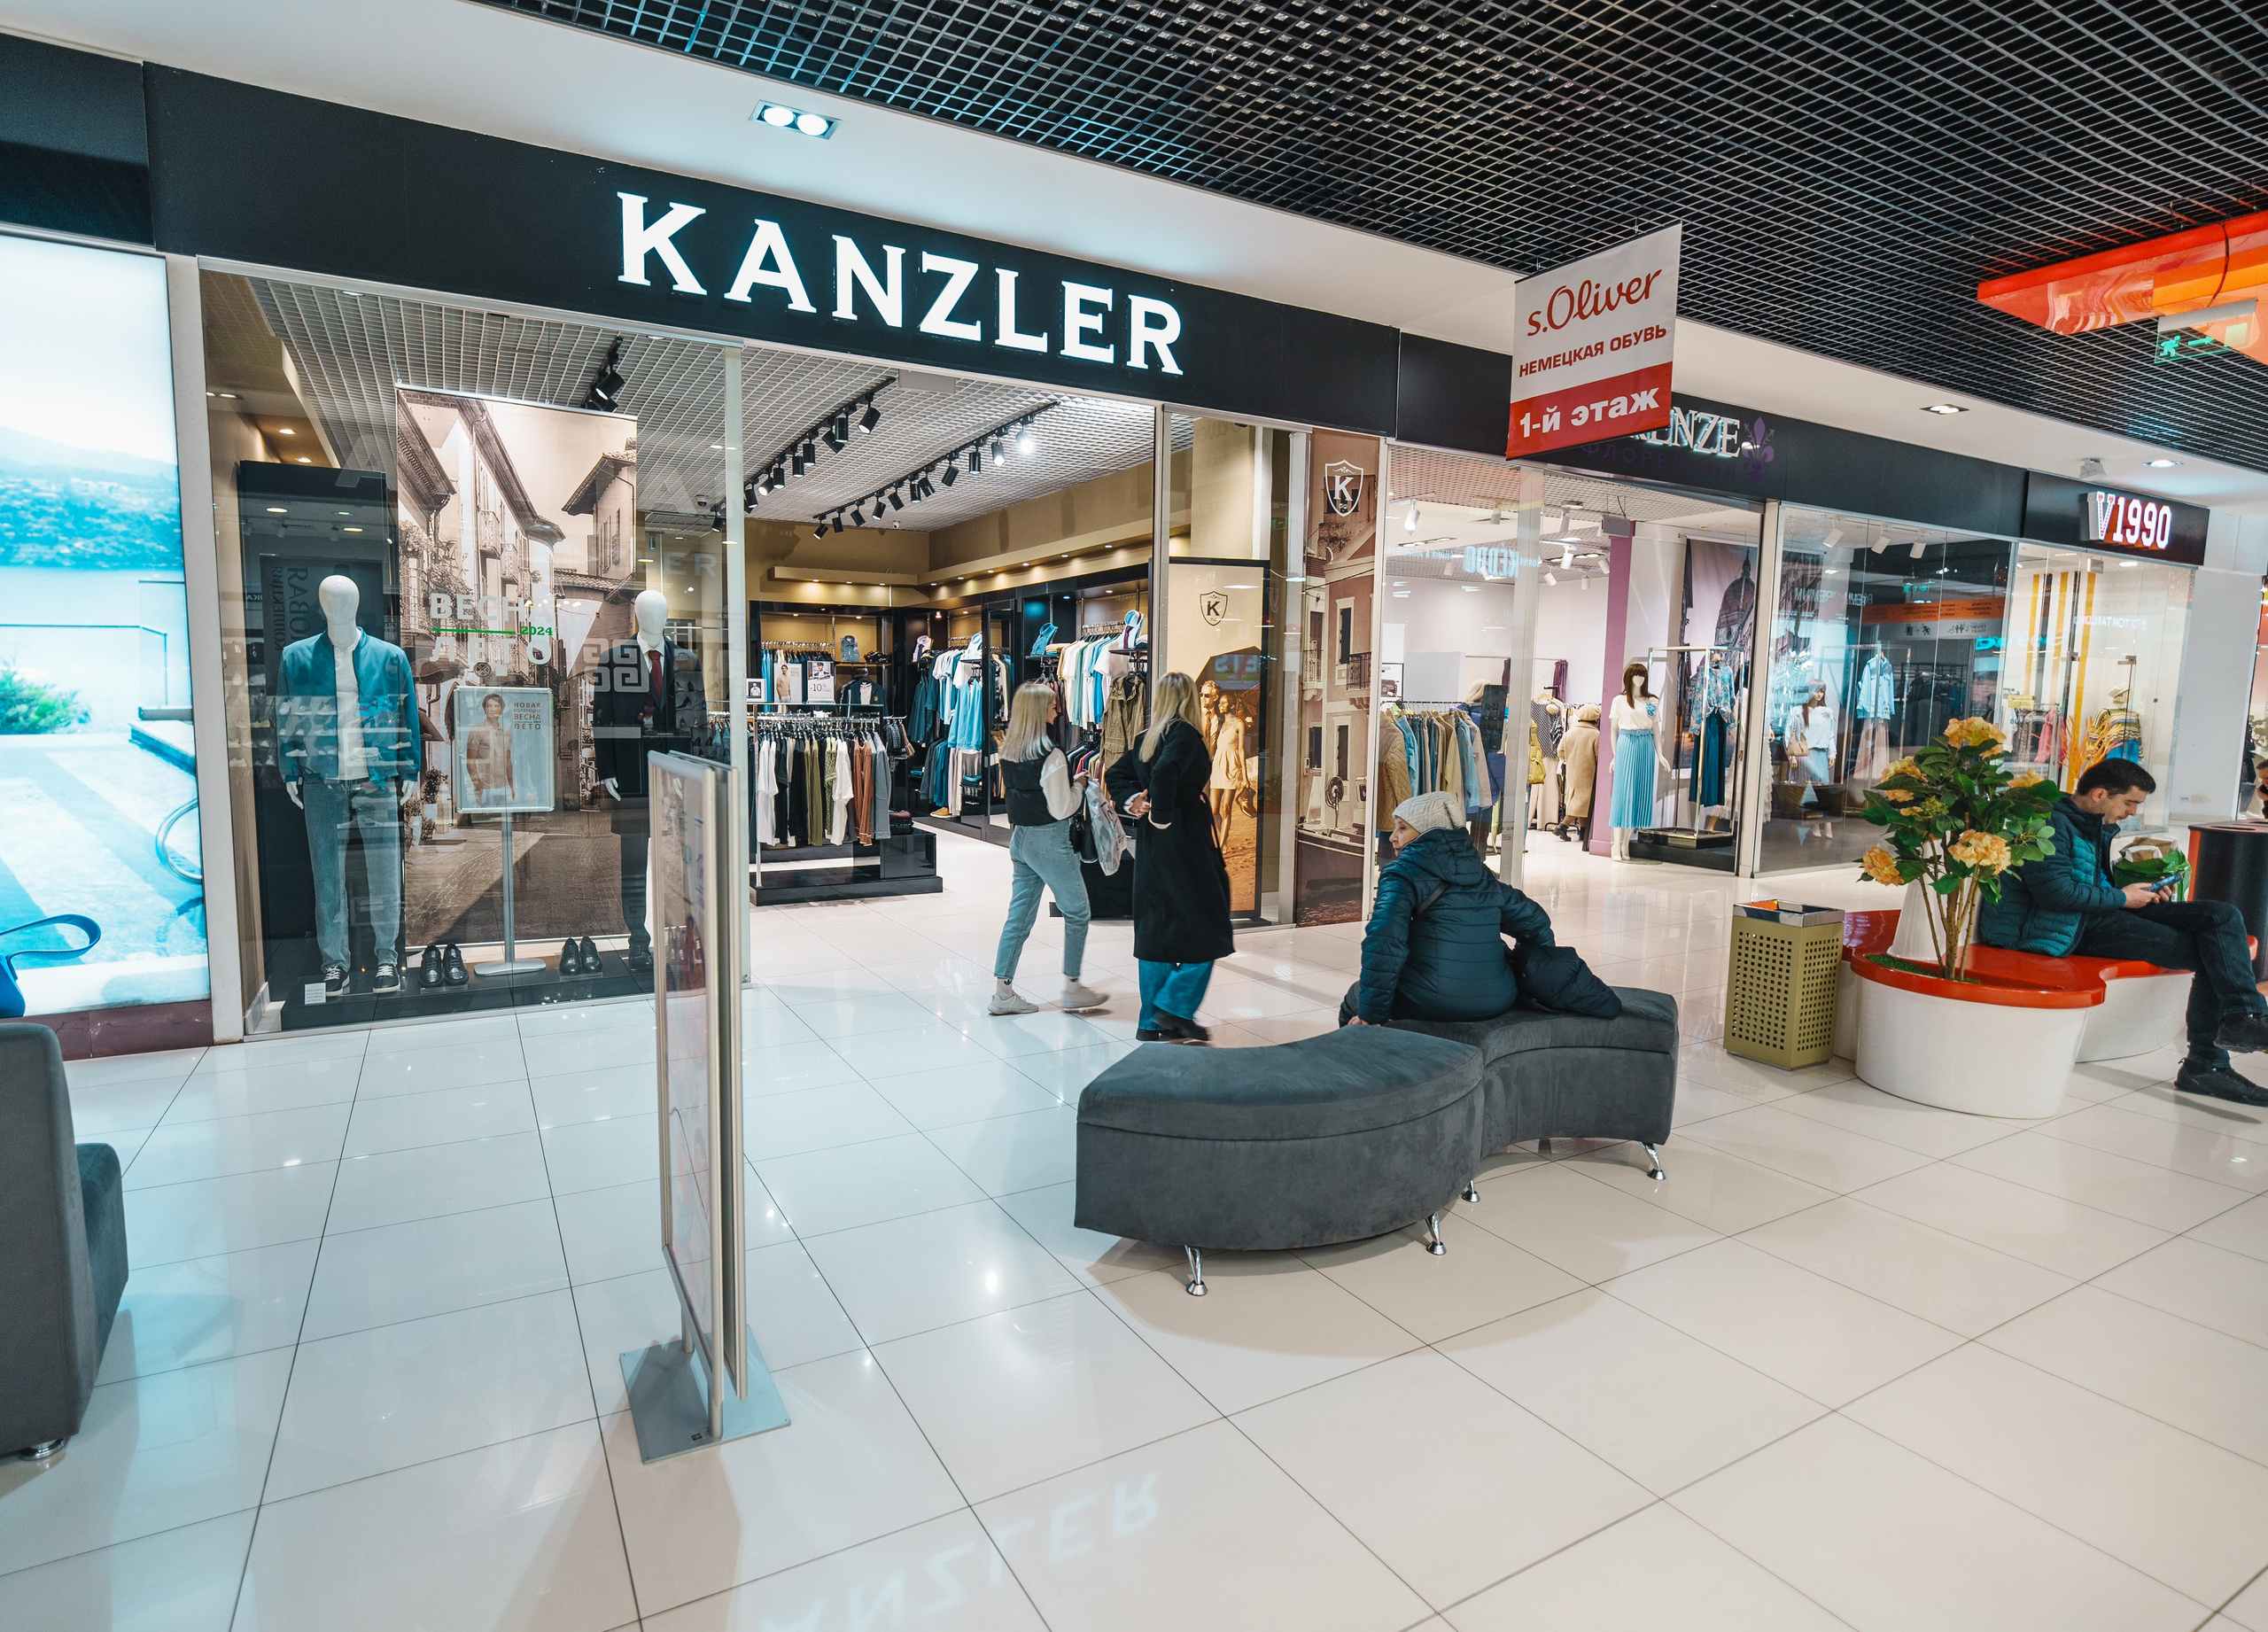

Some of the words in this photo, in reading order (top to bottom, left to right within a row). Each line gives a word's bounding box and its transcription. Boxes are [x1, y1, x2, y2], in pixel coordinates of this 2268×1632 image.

[616, 191, 1184, 377] KANZLER
[1526, 268, 1663, 337] s.Oliver
[1518, 340, 1604, 378] НЕМЕЦКАЯ
[1609, 323, 1667, 353] ОБУВЬ
[1519, 404, 1561, 439] 1-й
[1570, 386, 1659, 427] этаж
[1332, 474, 1355, 501] K
[2094, 490, 2172, 550] V1990
[431, 593, 555, 624] ВЕСНА
[1207, 600, 1220, 617] K
[429, 636, 552, 665] ЛЕТО
[520, 626, 553, 636] 2024
